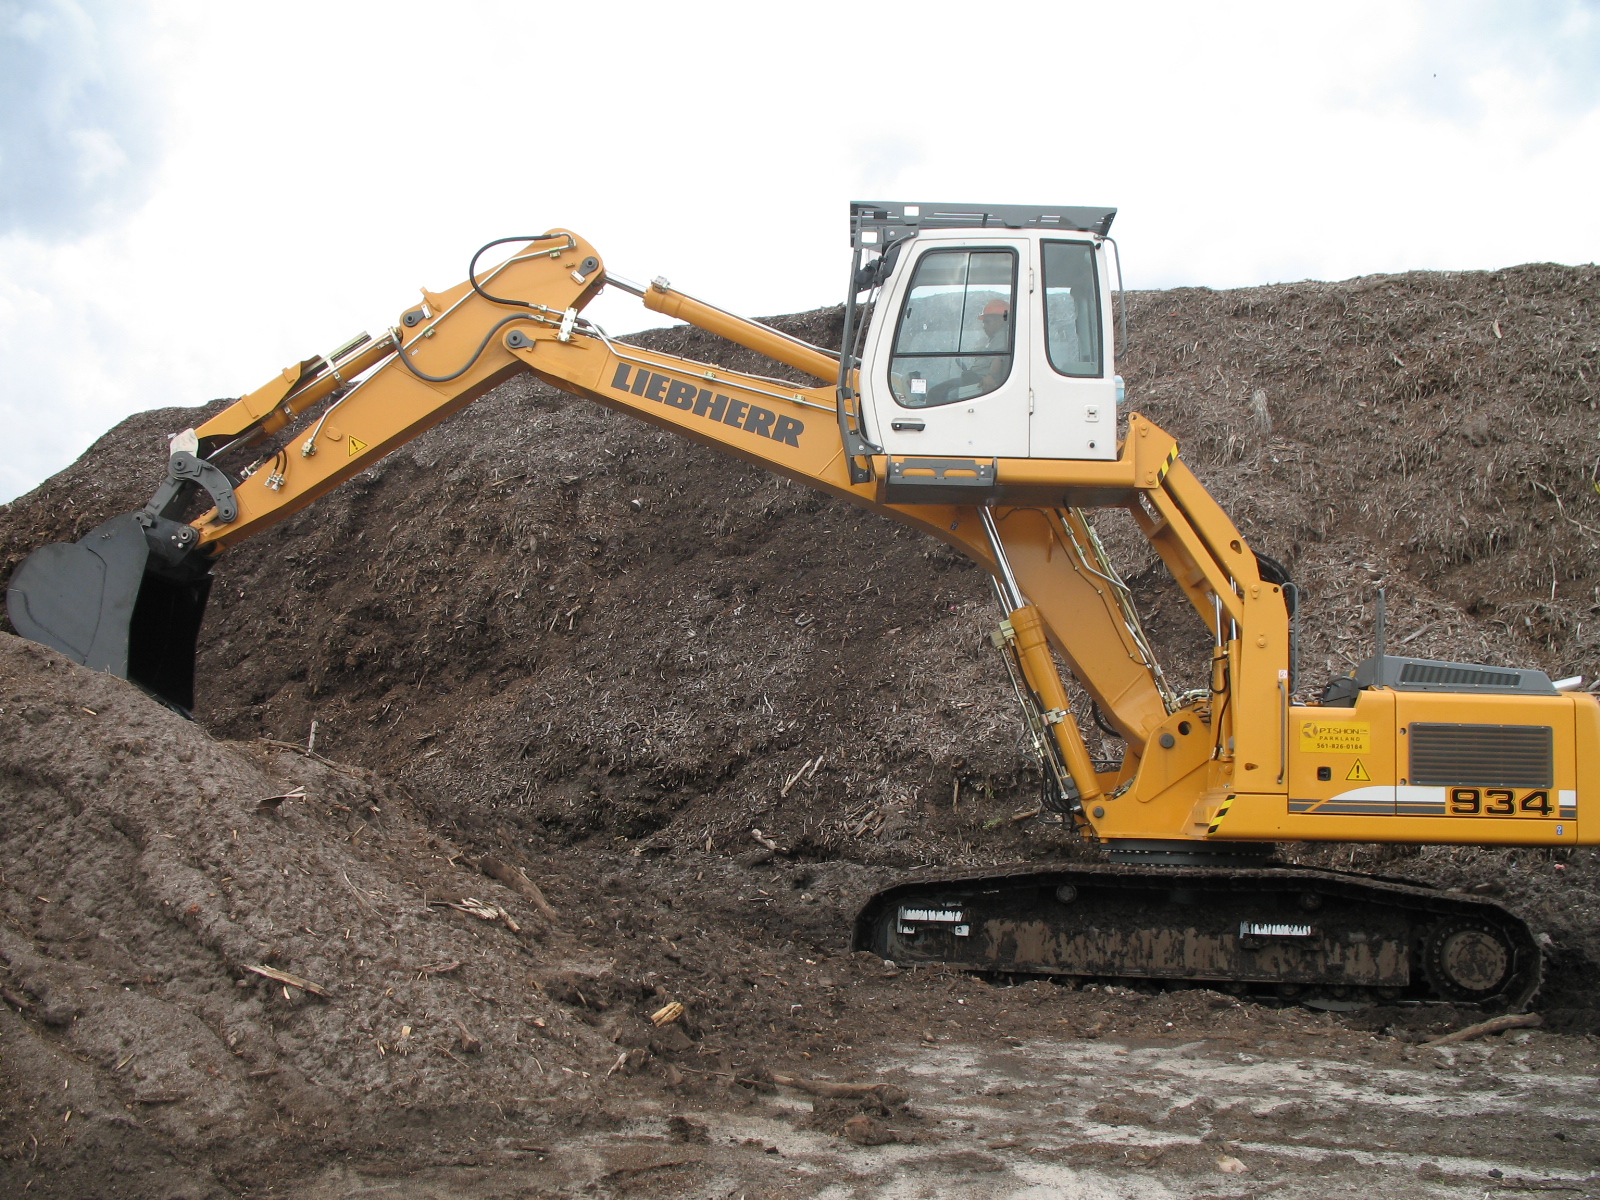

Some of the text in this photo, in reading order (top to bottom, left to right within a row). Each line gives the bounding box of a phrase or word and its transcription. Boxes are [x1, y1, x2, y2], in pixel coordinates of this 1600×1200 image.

[611, 362, 805, 448] LIEBHERR
[1319, 727, 1360, 735] PISHON
[1450, 787, 1555, 817] 934
